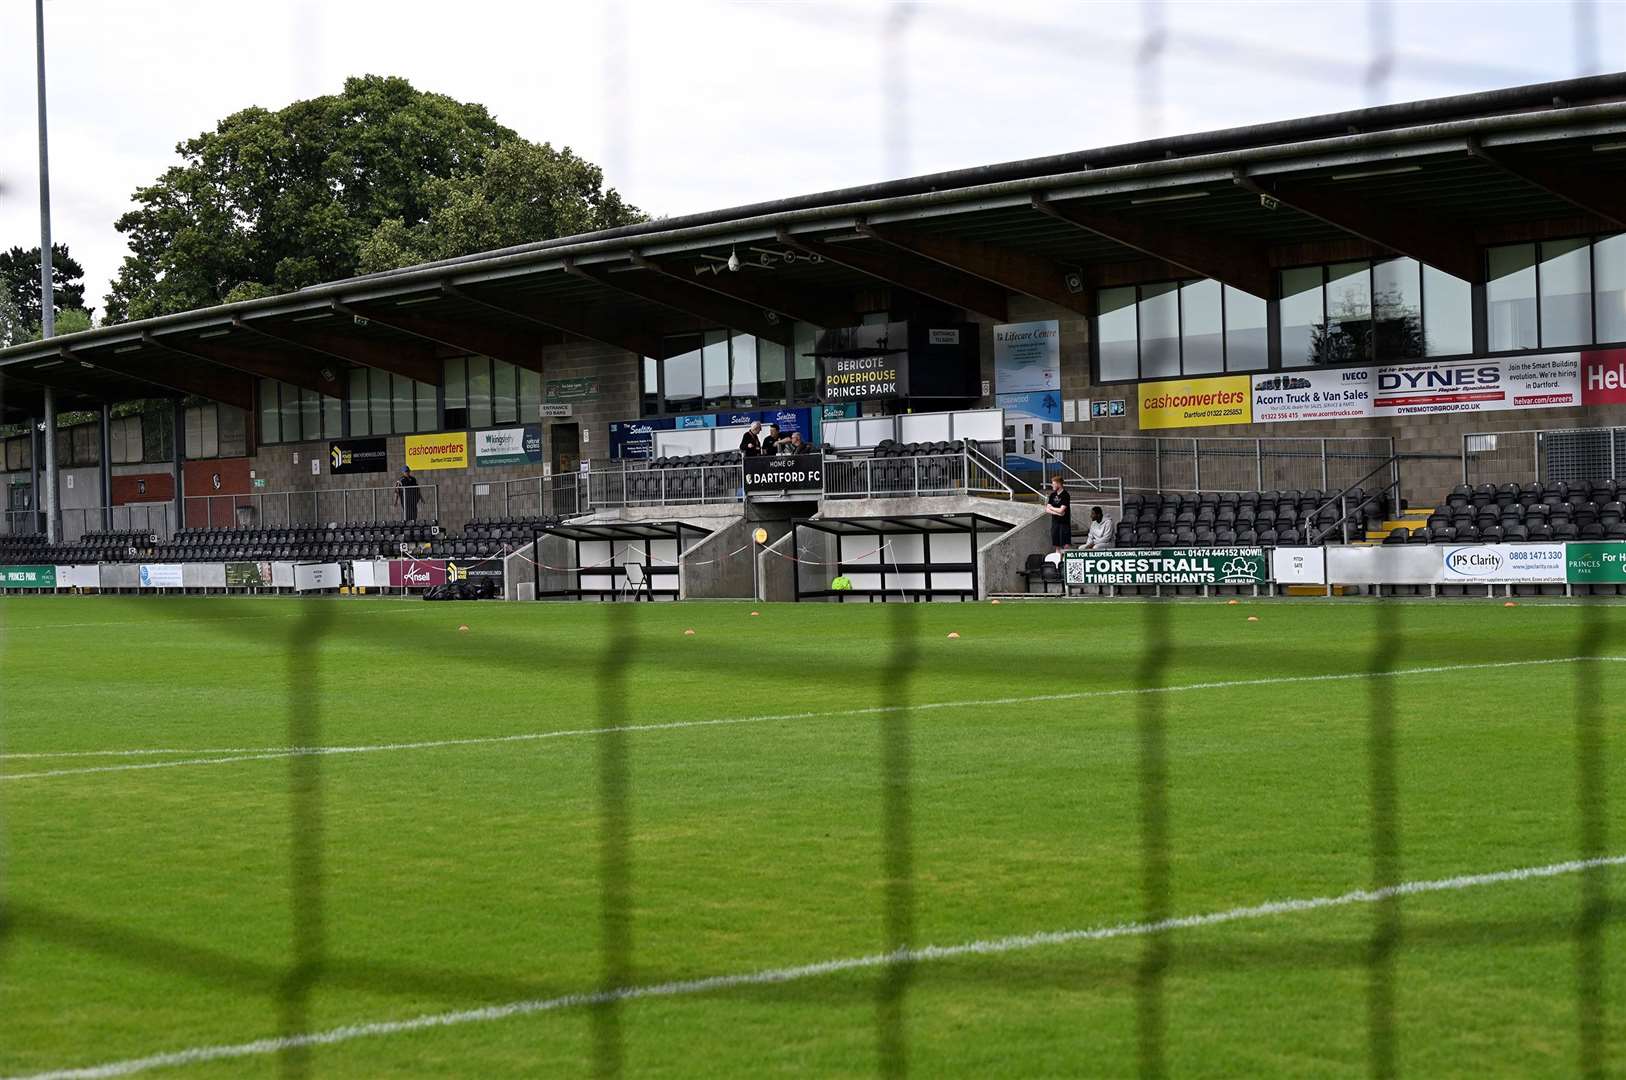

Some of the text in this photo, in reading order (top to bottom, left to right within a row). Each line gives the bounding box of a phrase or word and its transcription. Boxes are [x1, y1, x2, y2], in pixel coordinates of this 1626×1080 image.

[837, 357, 884, 371] BERICOTE
[1532, 361, 1551, 369] Smart
[1552, 360, 1577, 368] Building
[827, 370, 896, 385] POWERHOUSE
[1342, 371, 1368, 381] IVECO
[1378, 366, 1500, 390] DYNES
[1509, 370, 1577, 382] evolution. We're hiring
[827, 382, 896, 398] PRINCES PARK
[1532, 380, 1560, 389] Dartford.
[1144, 390, 1244, 410] cashconverters
[1256, 395, 1283, 405] Acorn
[1286, 393, 1310, 403] Truck
[1313, 392, 1320, 402] &
[1323, 391, 1341, 401] Van
[1343, 389, 1368, 400] Sales
[1514, 395, 1573, 405] helvar.com/careers
[1183, 410, 1206, 418] Dartford
[1206, 409, 1223, 417] 01322
[1397, 403, 1481, 414] DYNESMOTORGROUP.CO.UK
[1261, 412, 1277, 420] 01322
[1289, 411, 1299, 419] 415
[1302, 409, 1364, 418] www.acorntrucks.com
[408, 443, 464, 456] cashconverters
[753, 470, 820, 484] DARTFORD FC
[1187, 548, 1210, 557] 01474
[1211, 548, 1239, 557] 444152
[1239, 548, 1262, 556] NOW!!
[1509, 551, 1563, 560] 0808 1471 330
[1602, 552, 1616, 562] For
[1085, 559, 1215, 573] FORESTRALL
[1453, 554, 1468, 568] JPS
[1470, 553, 1501, 572] Clarity
[1568, 560, 1601, 568] PRINCES
[8, 572, 25, 581] PRINCES
[25, 572, 37, 581] PARK
[404, 562, 430, 585] Ansell
[1085, 573, 1215, 584] TIMBER MERCHANTS
